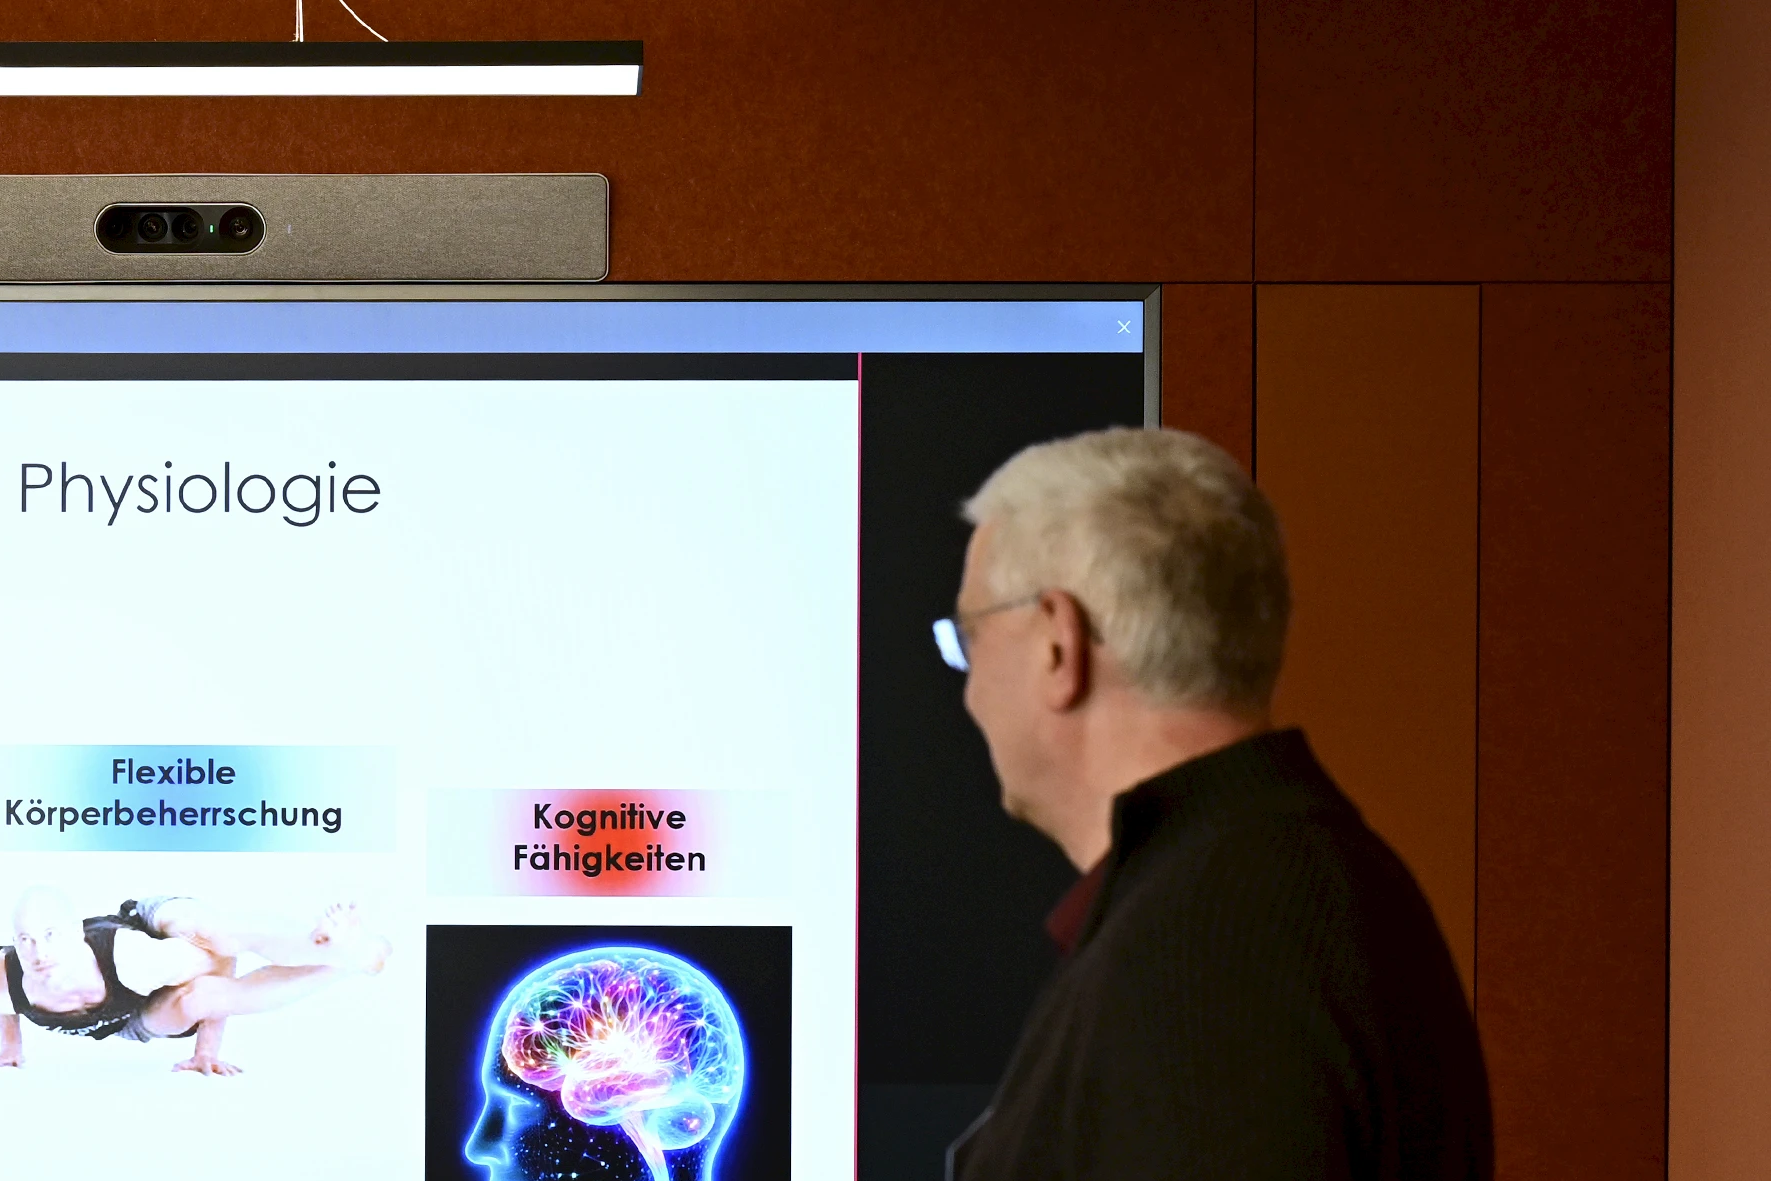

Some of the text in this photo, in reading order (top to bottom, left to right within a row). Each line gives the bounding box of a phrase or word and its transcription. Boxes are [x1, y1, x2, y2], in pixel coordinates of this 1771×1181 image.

[21, 460, 382, 528] Physiologie
[112, 758, 236, 785] Flexible
[5, 799, 343, 834] Körperbeherrschung
[534, 802, 686, 837] Kognitive
[514, 843, 706, 878] Fähigkeiten
